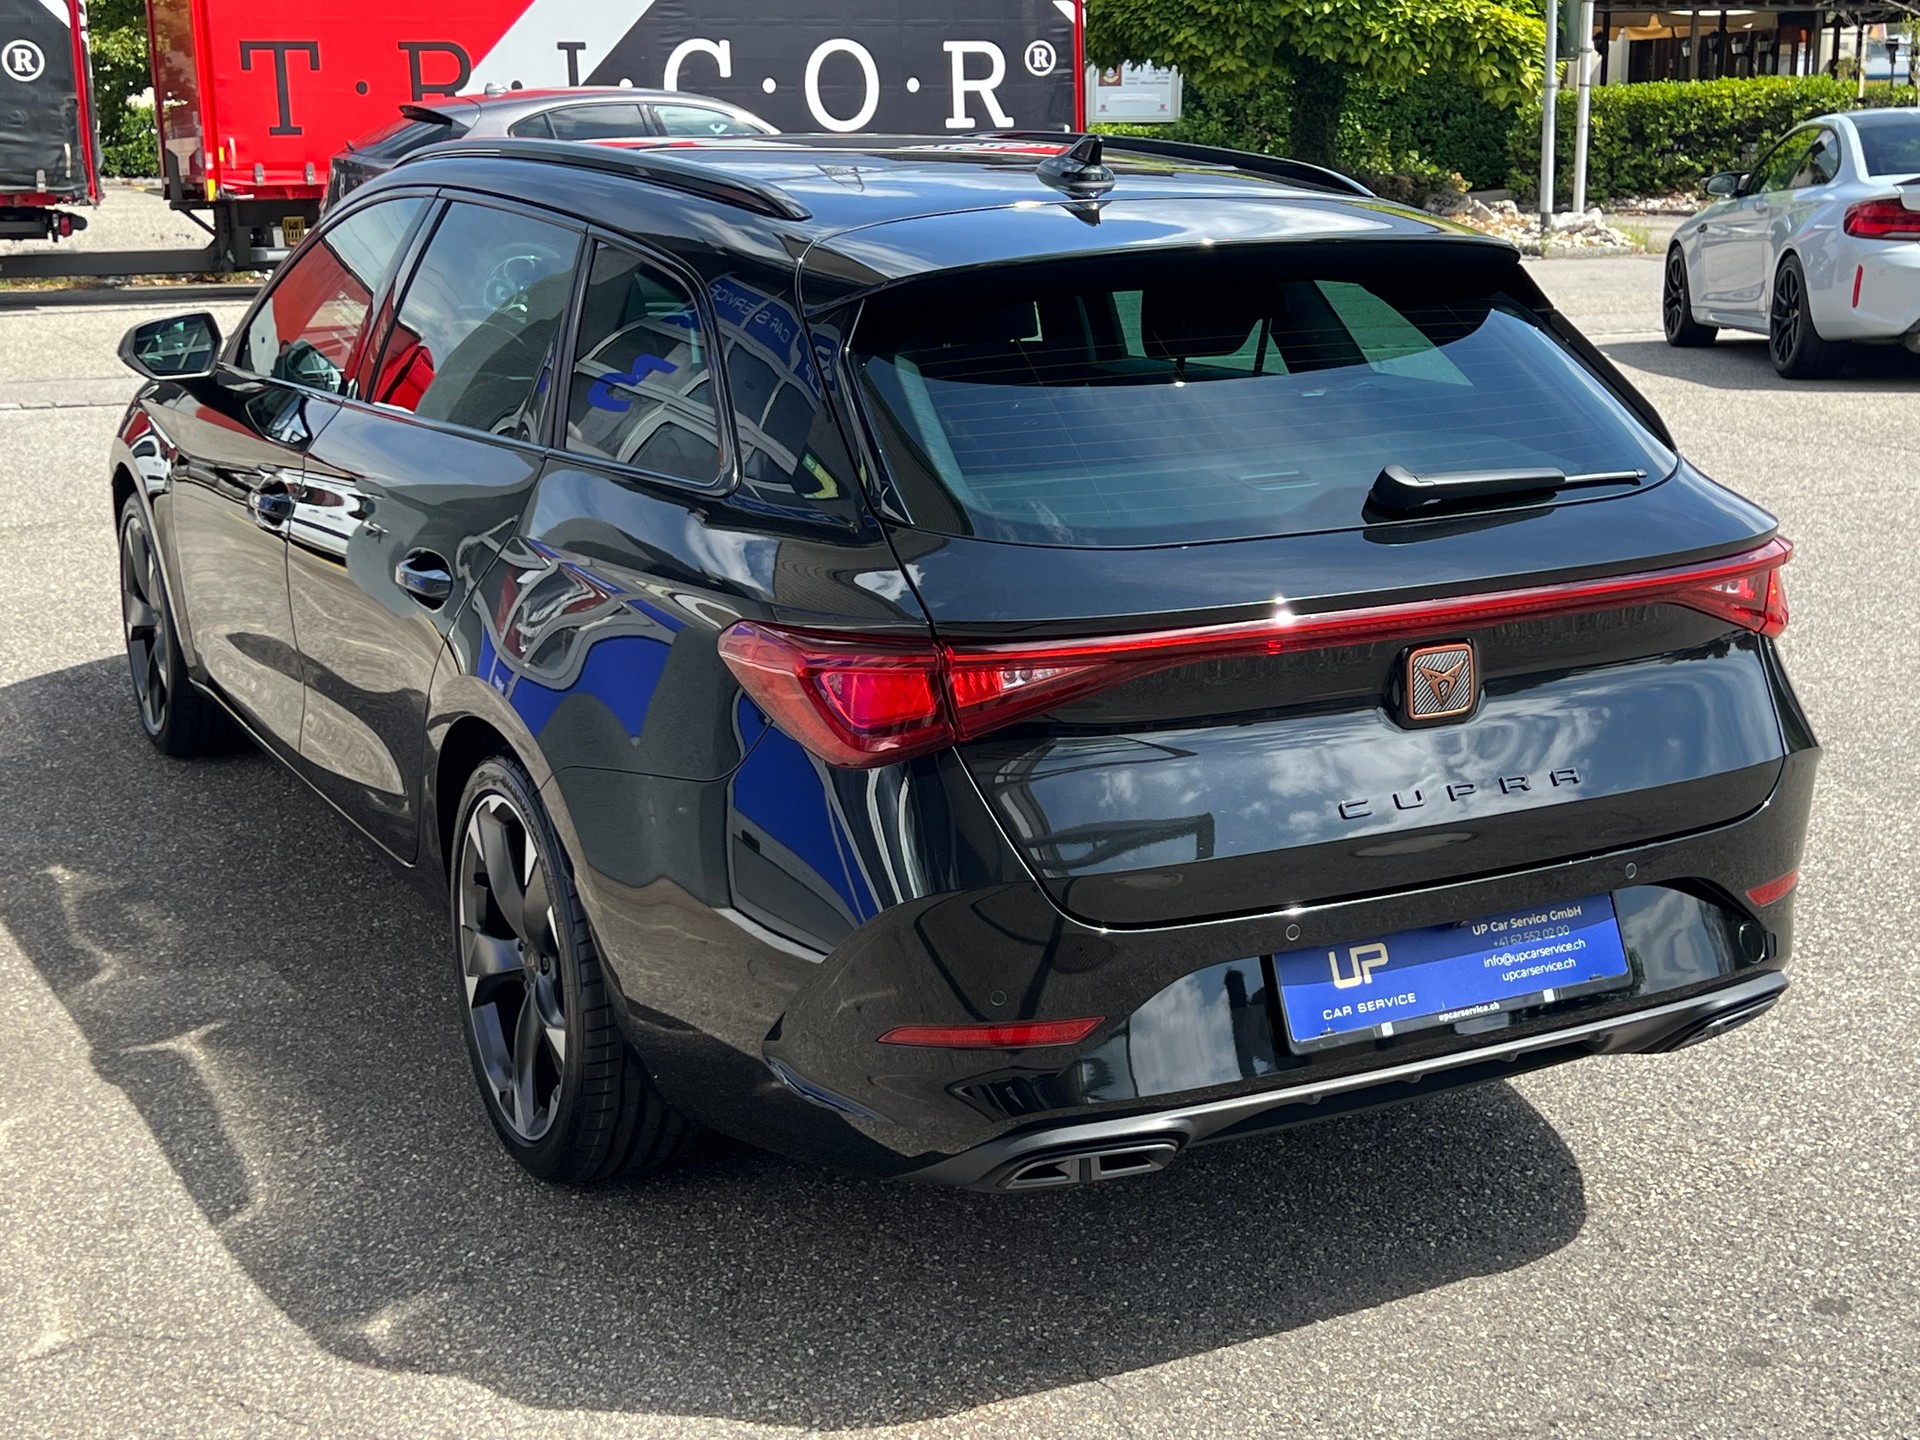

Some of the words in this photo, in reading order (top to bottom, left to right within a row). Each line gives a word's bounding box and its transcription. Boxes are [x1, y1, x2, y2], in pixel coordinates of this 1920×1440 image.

[1338, 767, 1582, 820] CUPRA
[1472, 924, 1488, 936] UP
[1490, 921, 1508, 932] Car
[1510, 913, 1548, 929] Service
[1549, 905, 1582, 921] GmbH
[1493, 937, 1508, 947] +41
[1510, 933, 1521, 945] 62
[1523, 930, 1542, 943] 552
[1542, 927, 1555, 939] 02
[1556, 924, 1570, 936] 00
[1328, 942, 1389, 989] UP
[1483, 938, 1586, 968] info@upcarservice.ch
[1501, 957, 1577, 982] upcarservice.ch
[1322, 1002, 1353, 1020] CAR
[1357, 992, 1417, 1013] SERVICE
[1438, 1001, 1500, 1022] upcarservice.ch
